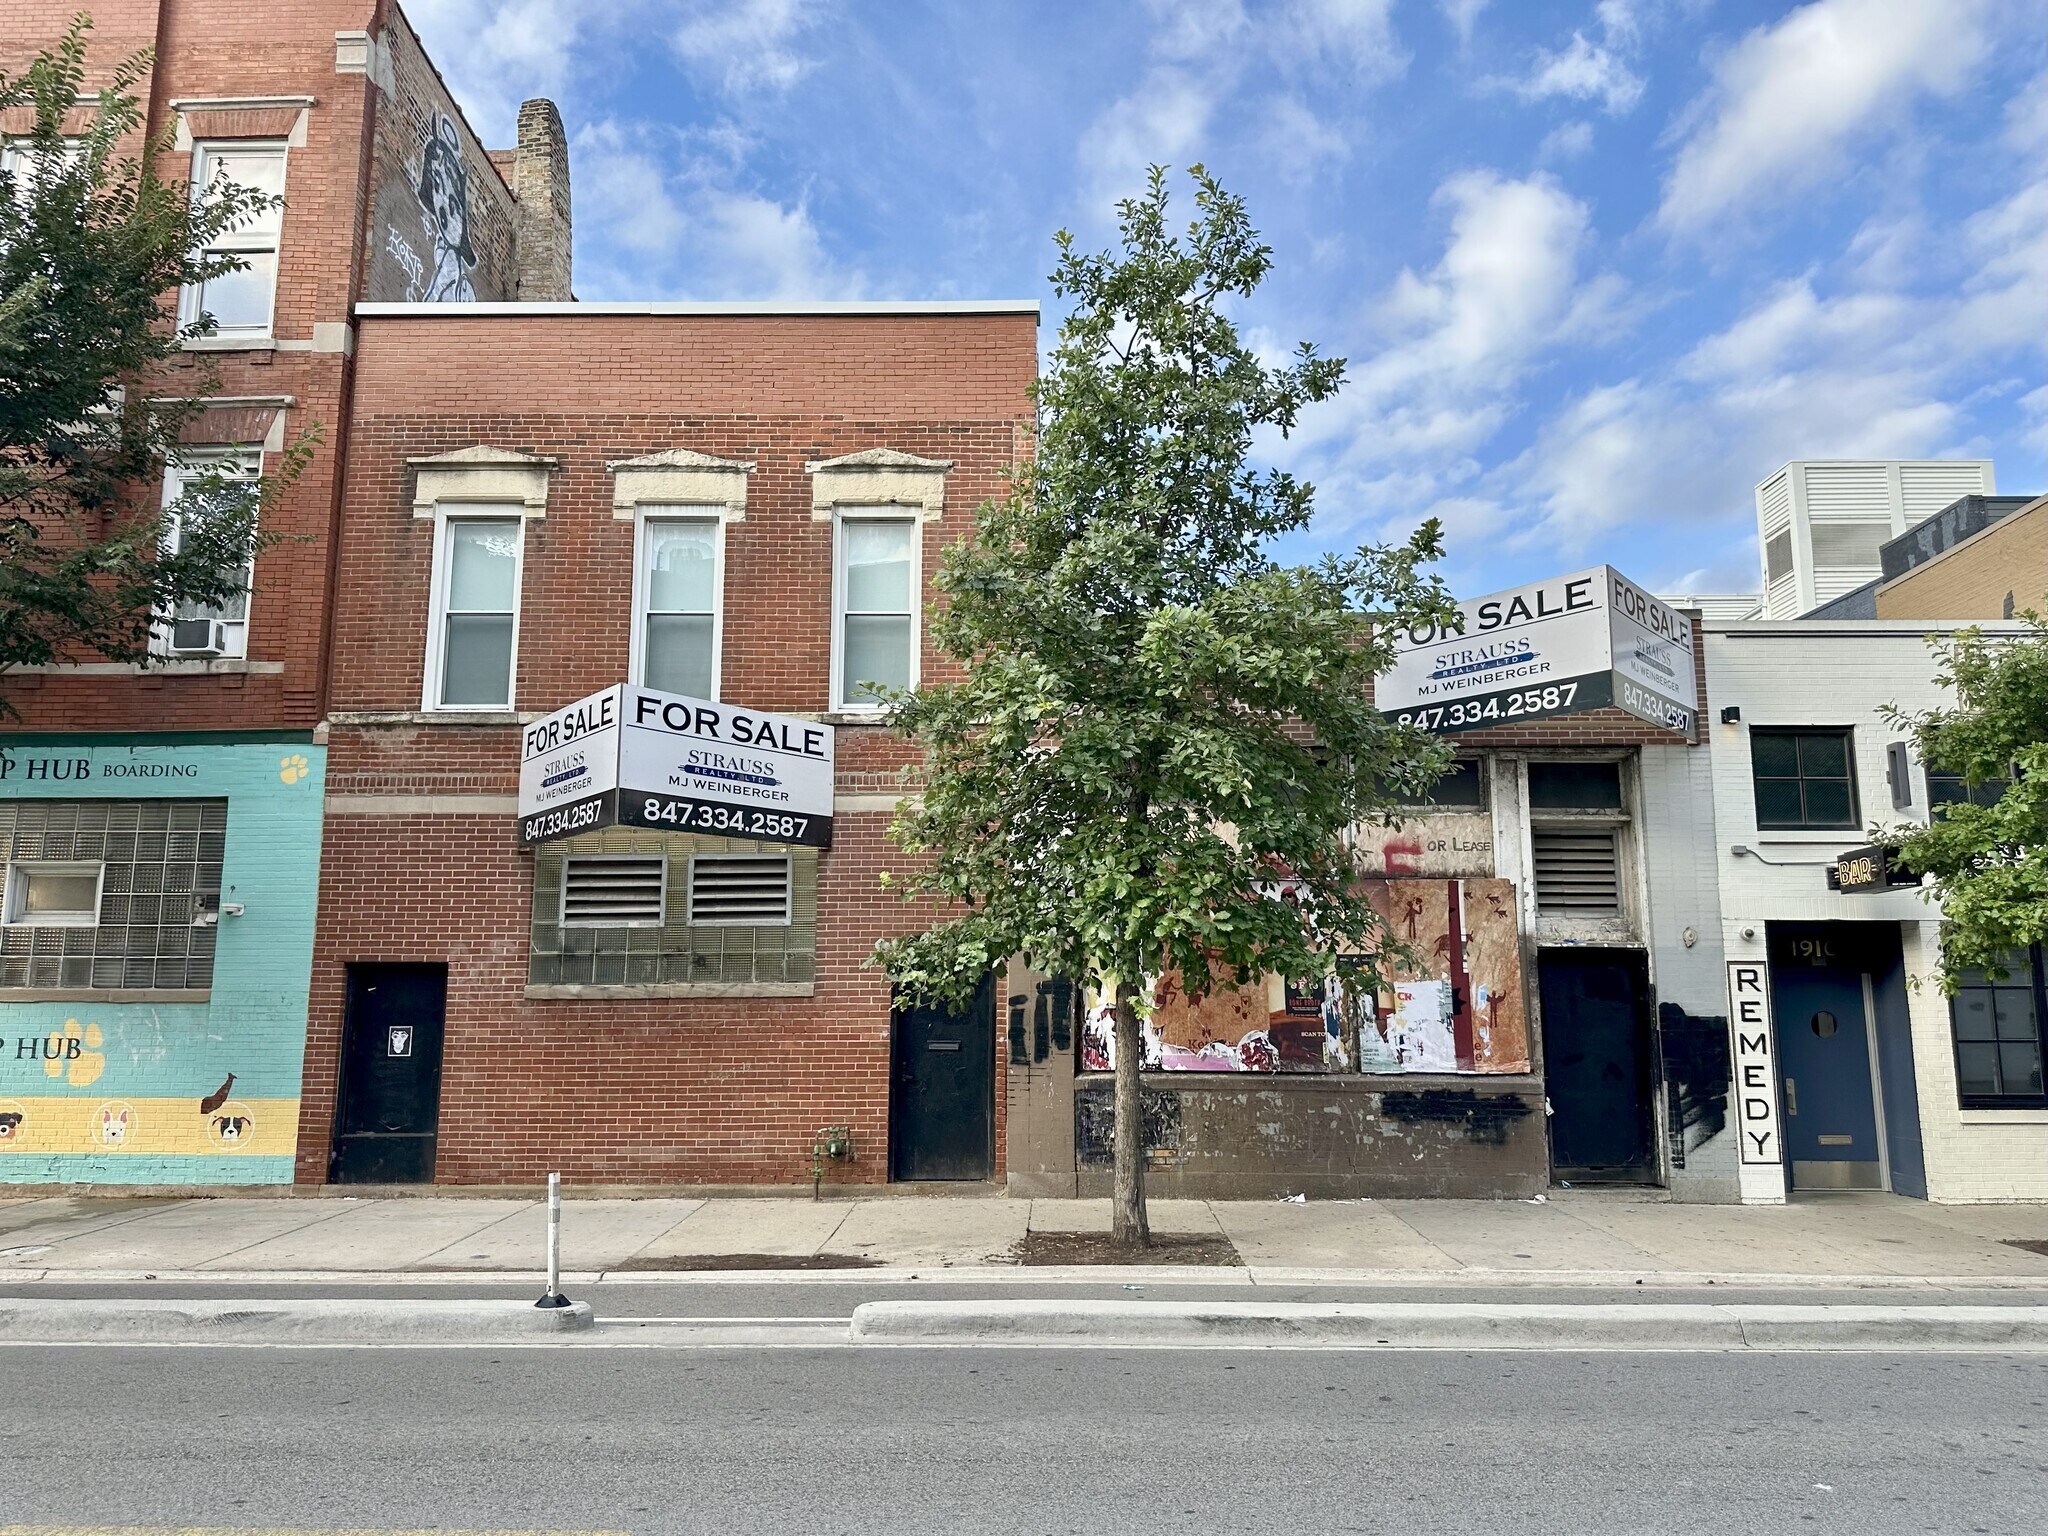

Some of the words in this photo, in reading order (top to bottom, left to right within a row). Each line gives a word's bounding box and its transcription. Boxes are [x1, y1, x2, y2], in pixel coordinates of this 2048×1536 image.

[1478, 577, 1594, 629] SALE
[1614, 578, 1648, 626] FOR
[1650, 604, 1690, 650] SALE
[1436, 637, 1530, 669] STRAUSS
[1636, 635, 1672, 667] STRAUSS
[1419, 684, 1437, 696] MJ
[1442, 662, 1551, 691] WEINBERGER
[1631, 660, 1639, 673] MJ
[1641, 667, 1680, 693] WEINBERGER
[1398, 682, 1578, 731] 847.334.2587
[1624, 682, 1689, 731] 847.334.2587
[526, 720, 559, 757] FOR
[563, 695, 614, 741] SALE
[636, 695, 720, 738] FOR
[731, 716, 825, 757] SALE
[26, 759, 91, 780] HUB
[103, 764, 198, 777] BOARDING
[544, 750, 585, 778] STRAUSS
[688, 750, 774, 776] STRAUSS
[536, 793, 545, 803] MJ
[546, 776, 592, 801] WEINBERGER
[668, 775, 688, 787] MJ
[693, 780, 789, 802] WEINBERGER
[525, 799, 602, 841] 847.334.2587
[643, 799, 808, 838] 847.334.2587
[1838, 857, 1872, 885] BAR
[15, 1037, 82, 1060] HUB
[1736, 969, 1771, 1156] REMEDY
